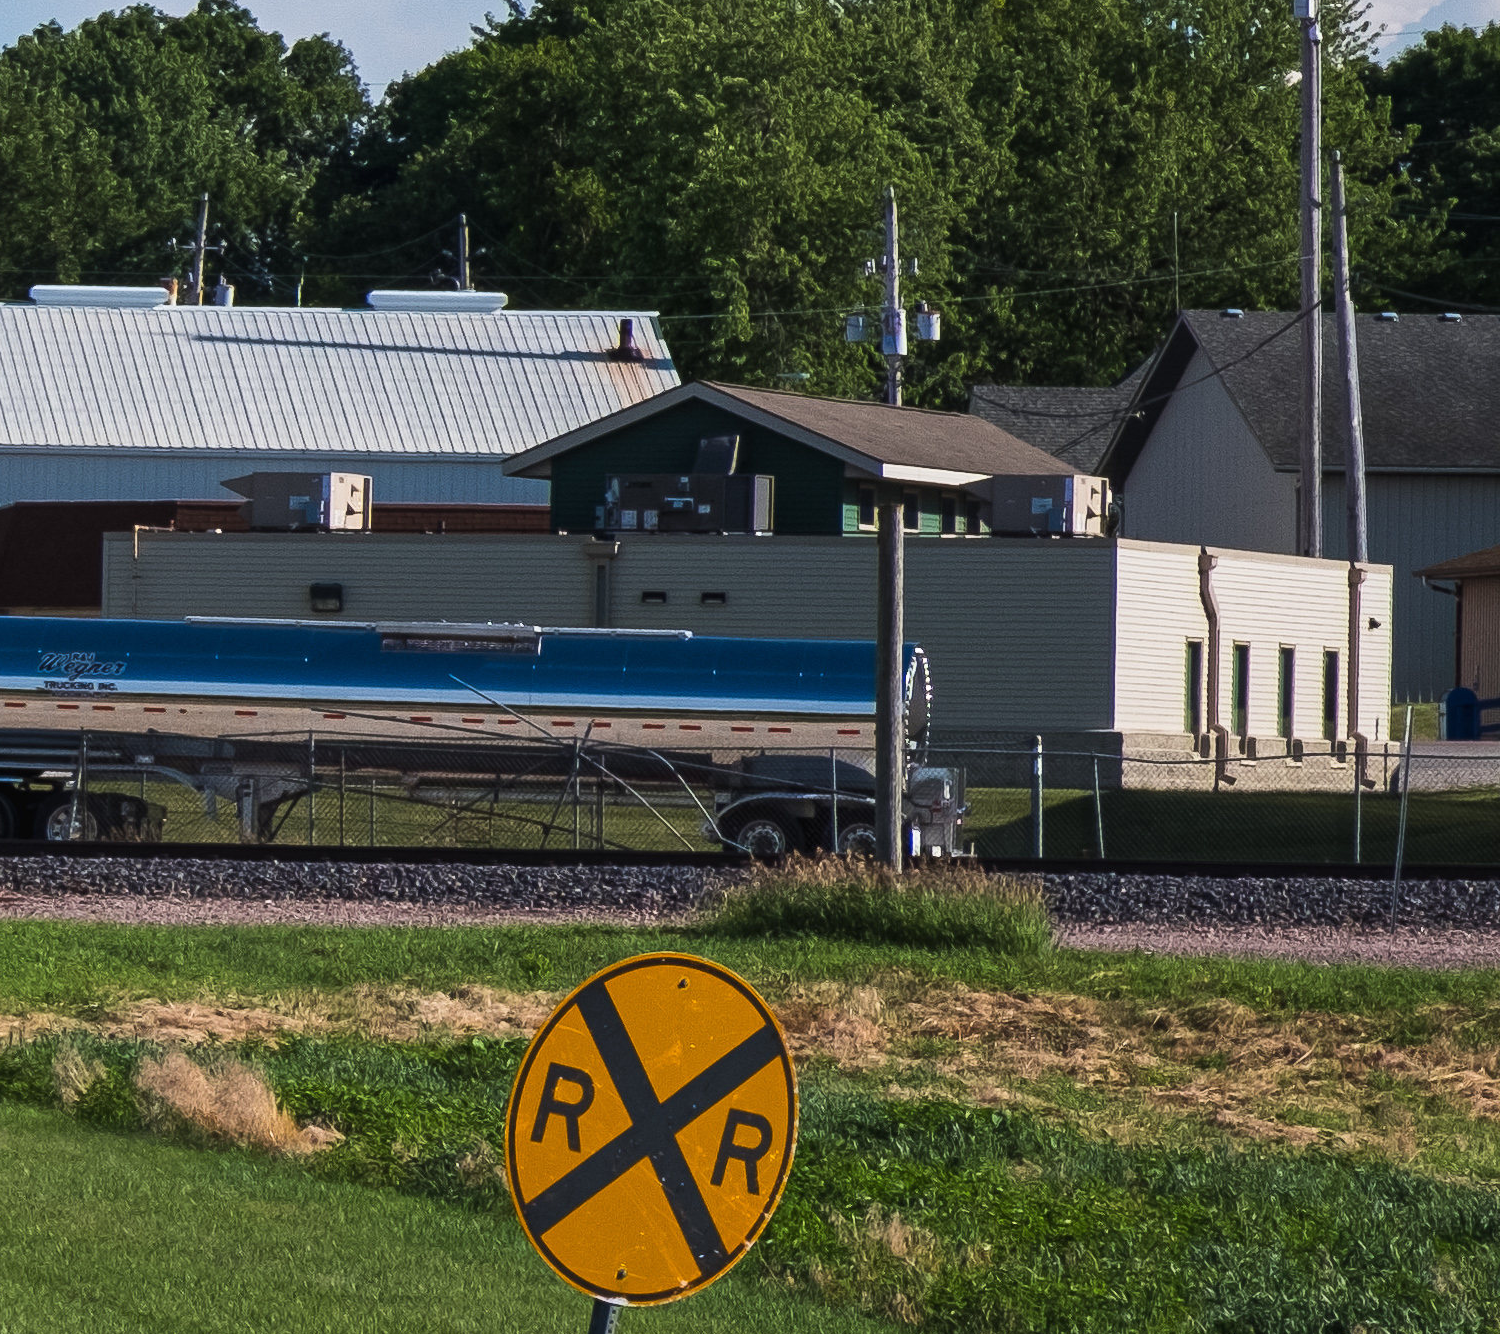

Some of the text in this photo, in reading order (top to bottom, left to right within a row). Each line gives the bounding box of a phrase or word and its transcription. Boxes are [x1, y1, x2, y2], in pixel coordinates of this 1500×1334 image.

[38, 653, 127, 682] Wegner
[44, 680, 95, 690] TRUCKING
[530, 1061, 773, 1196] R R
